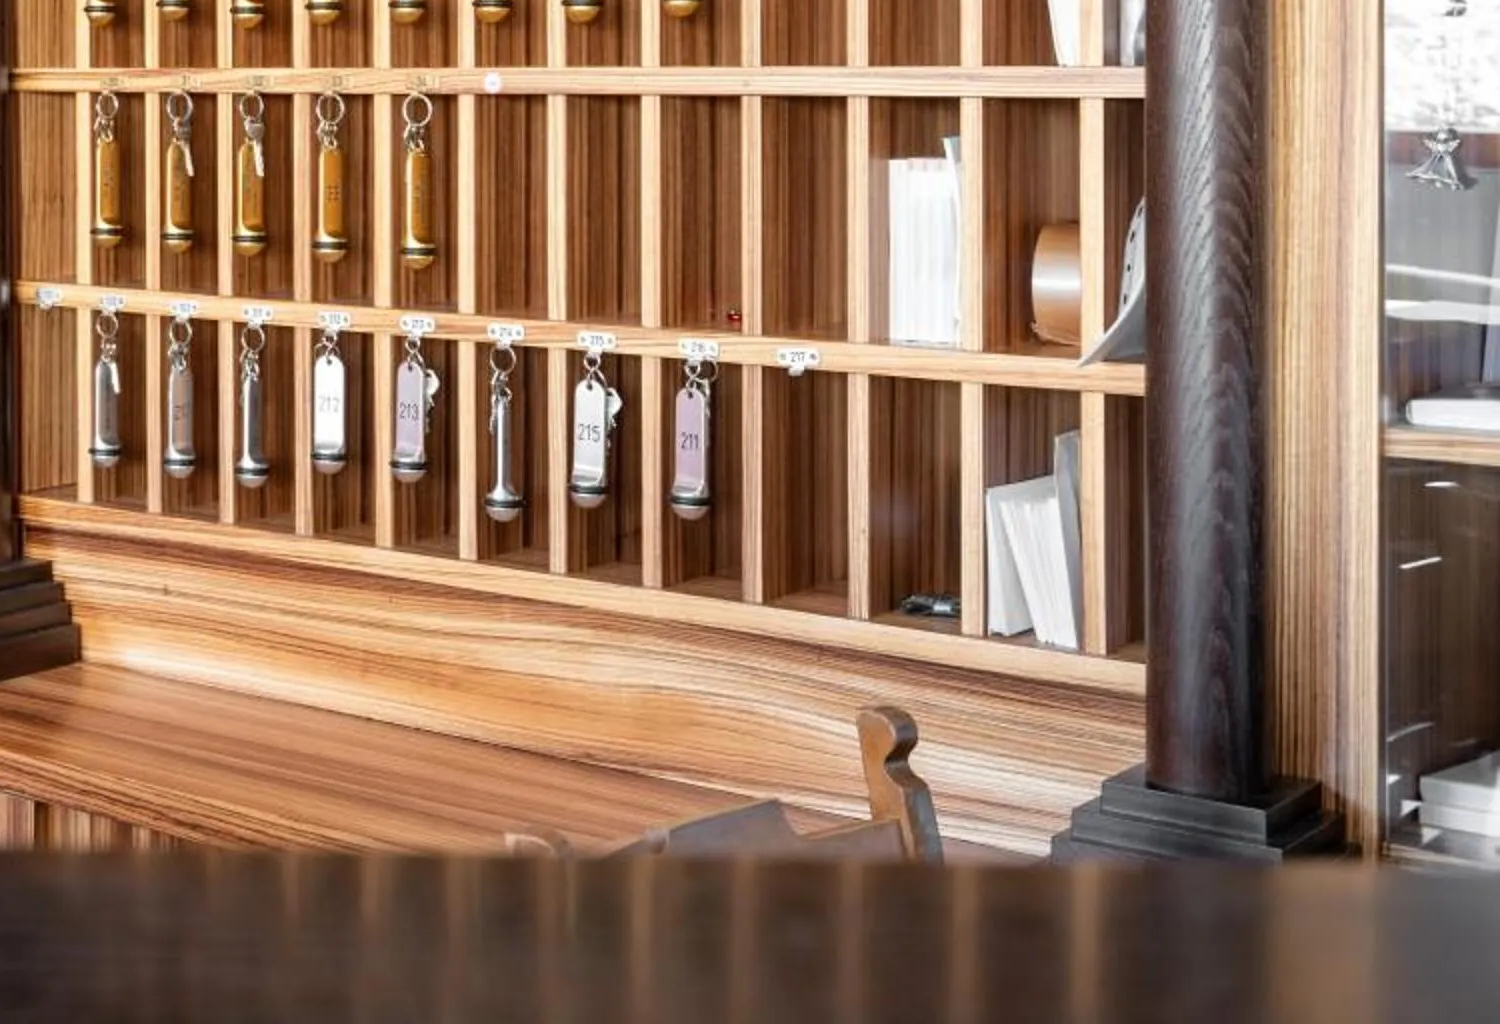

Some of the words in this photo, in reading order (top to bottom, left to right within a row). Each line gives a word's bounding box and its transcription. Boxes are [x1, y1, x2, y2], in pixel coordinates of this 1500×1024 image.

[790, 351, 807, 363] 217
[318, 394, 341, 414] 212
[399, 402, 420, 422] 213
[577, 423, 601, 443] 215
[680, 432, 700, 451] 211
